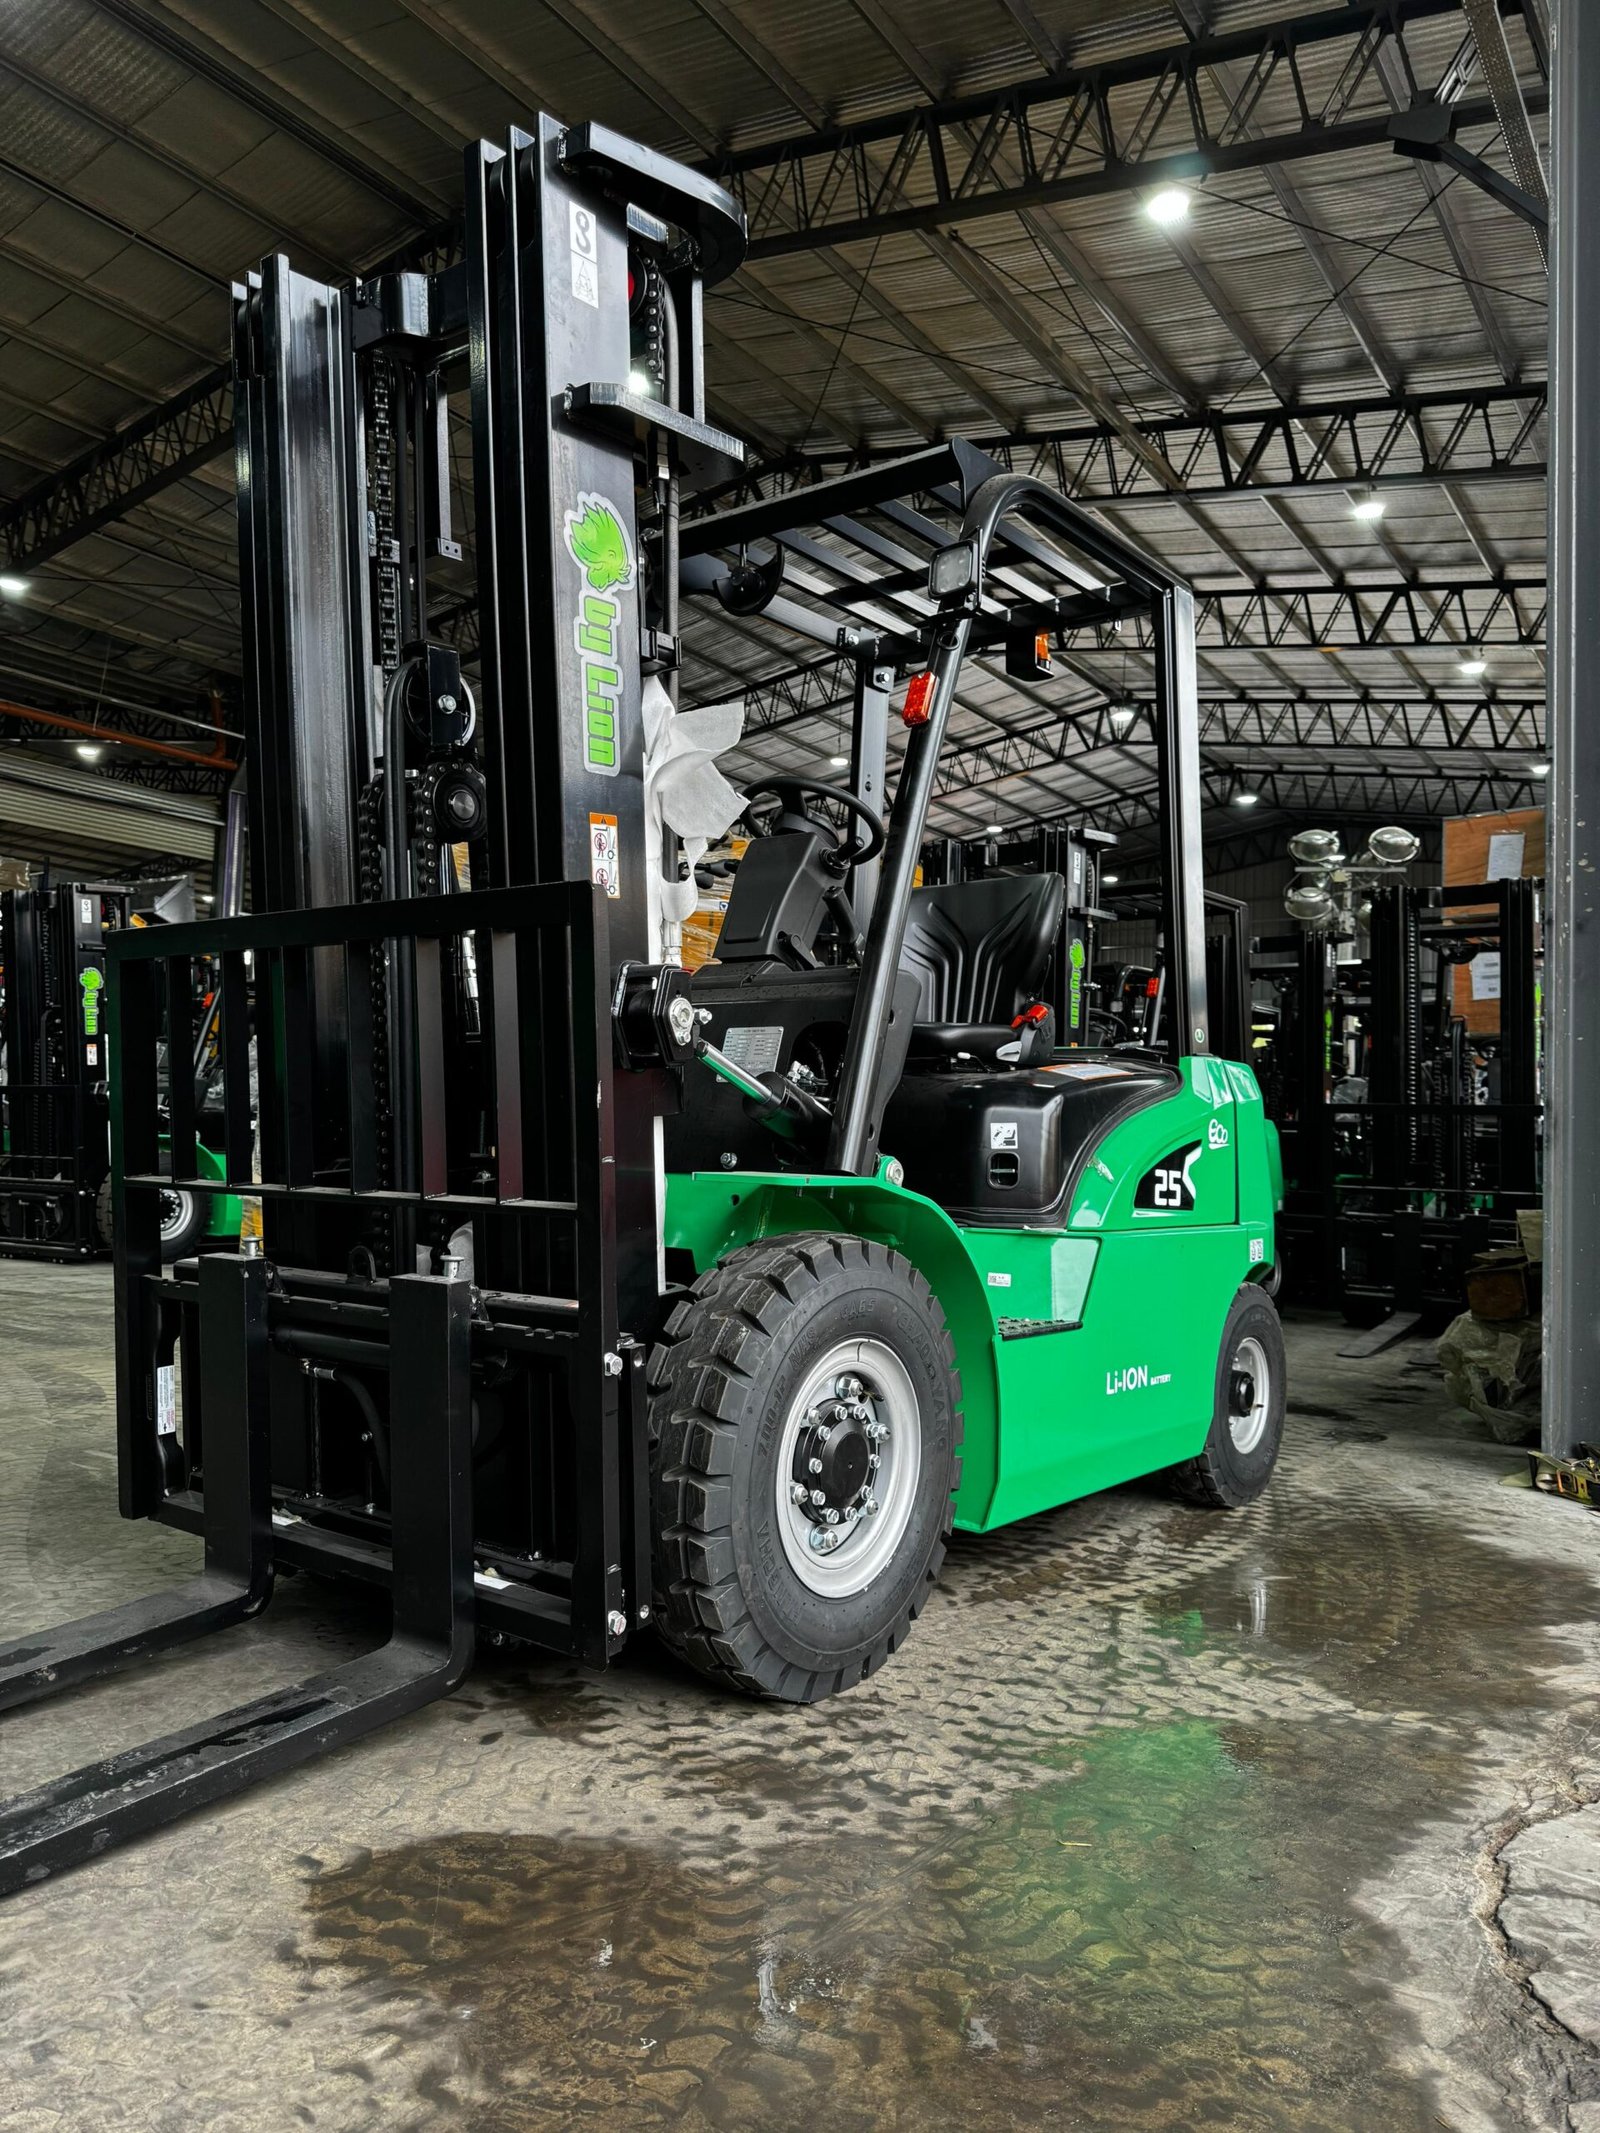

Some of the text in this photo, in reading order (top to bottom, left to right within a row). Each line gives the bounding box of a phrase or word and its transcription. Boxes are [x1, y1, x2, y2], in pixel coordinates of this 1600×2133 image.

[579, 596, 619, 767] by Lion
[1153, 1169, 1182, 1206] 25
[1106, 1364, 1148, 1395] Li-ION
